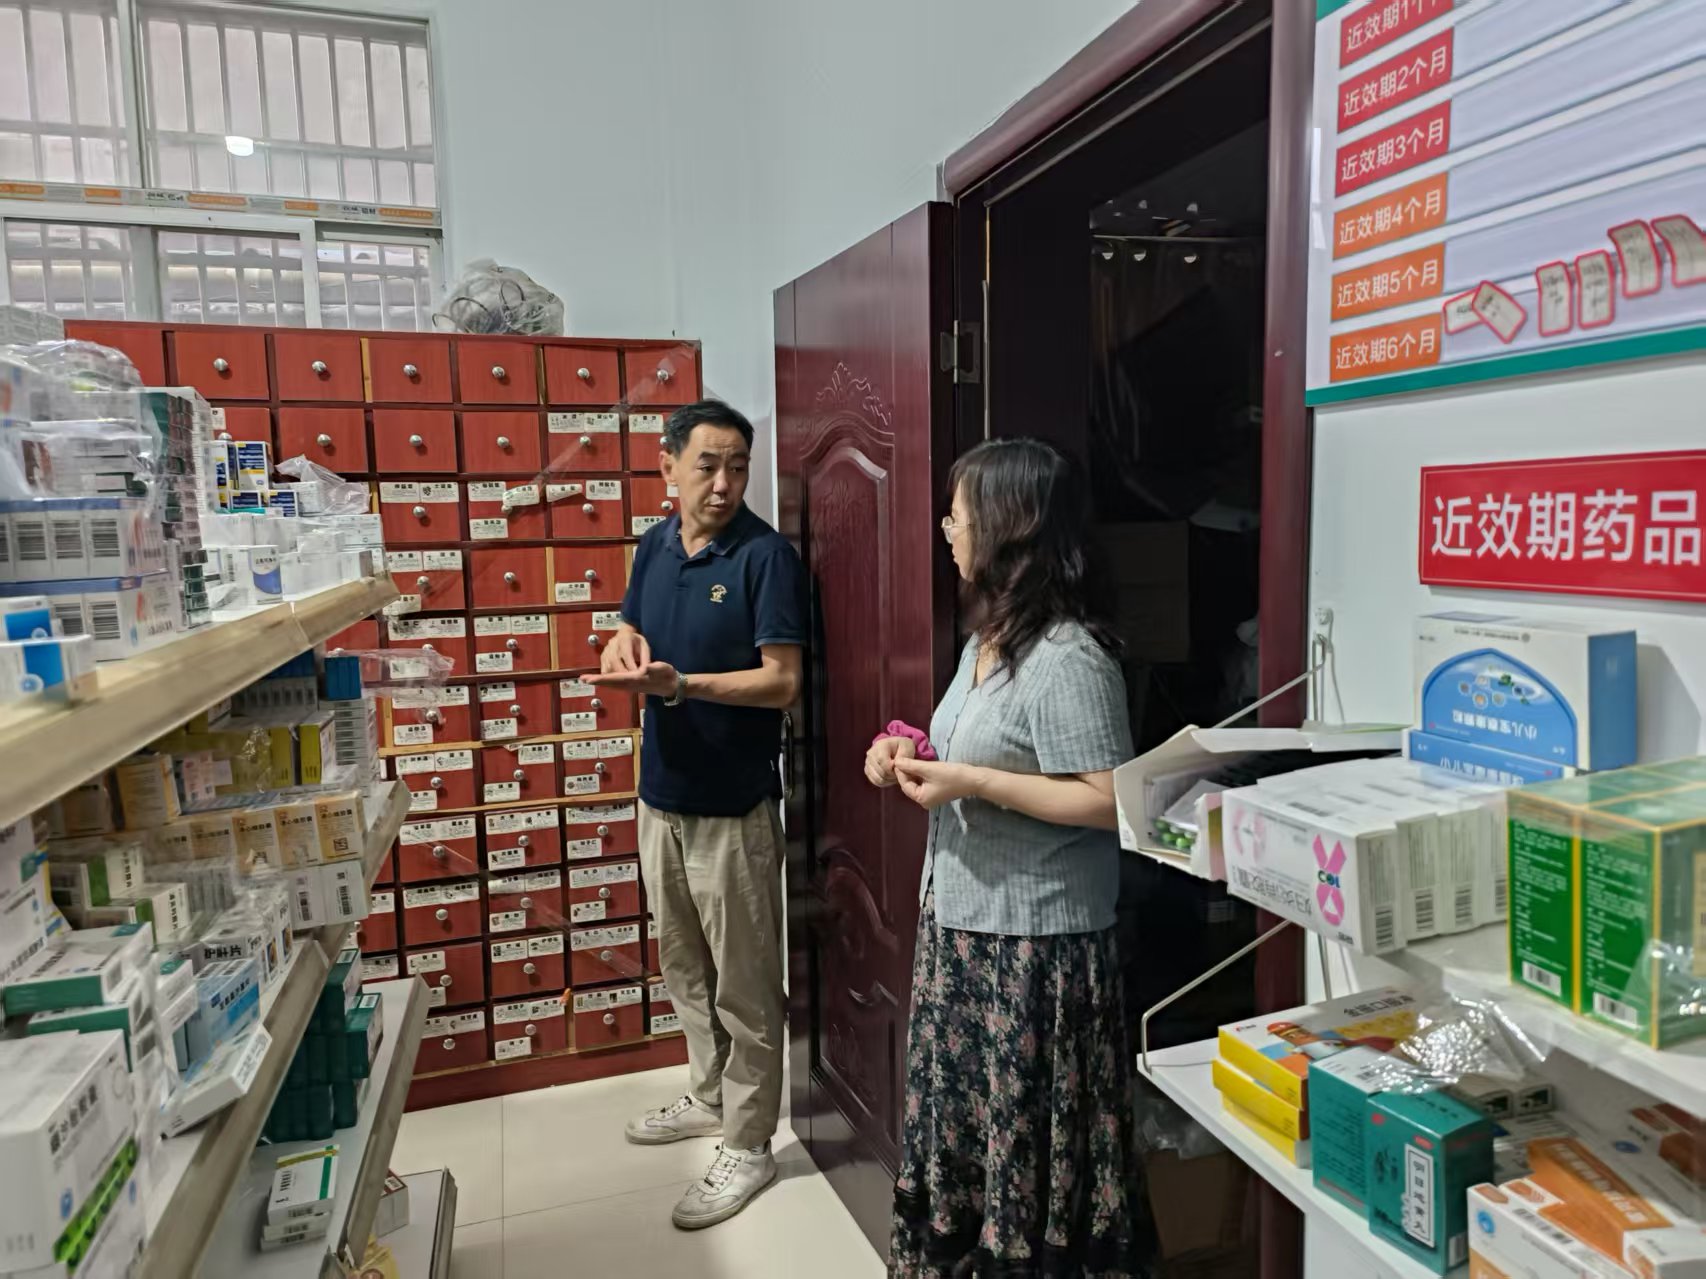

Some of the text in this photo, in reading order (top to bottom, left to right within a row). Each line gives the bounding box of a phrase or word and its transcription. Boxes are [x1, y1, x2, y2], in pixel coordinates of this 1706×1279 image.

[1343, 45, 1448, 118] 近效期2个月
[1341, 117, 1446, 183] 近效期3个月
[1339, 189, 1442, 245] 近效期4个月
[1336, 259, 1439, 309] 近效期5个月
[1335, 329, 1437, 371] 近效期6个月
[1430, 488, 1701, 567] 近效期药品
